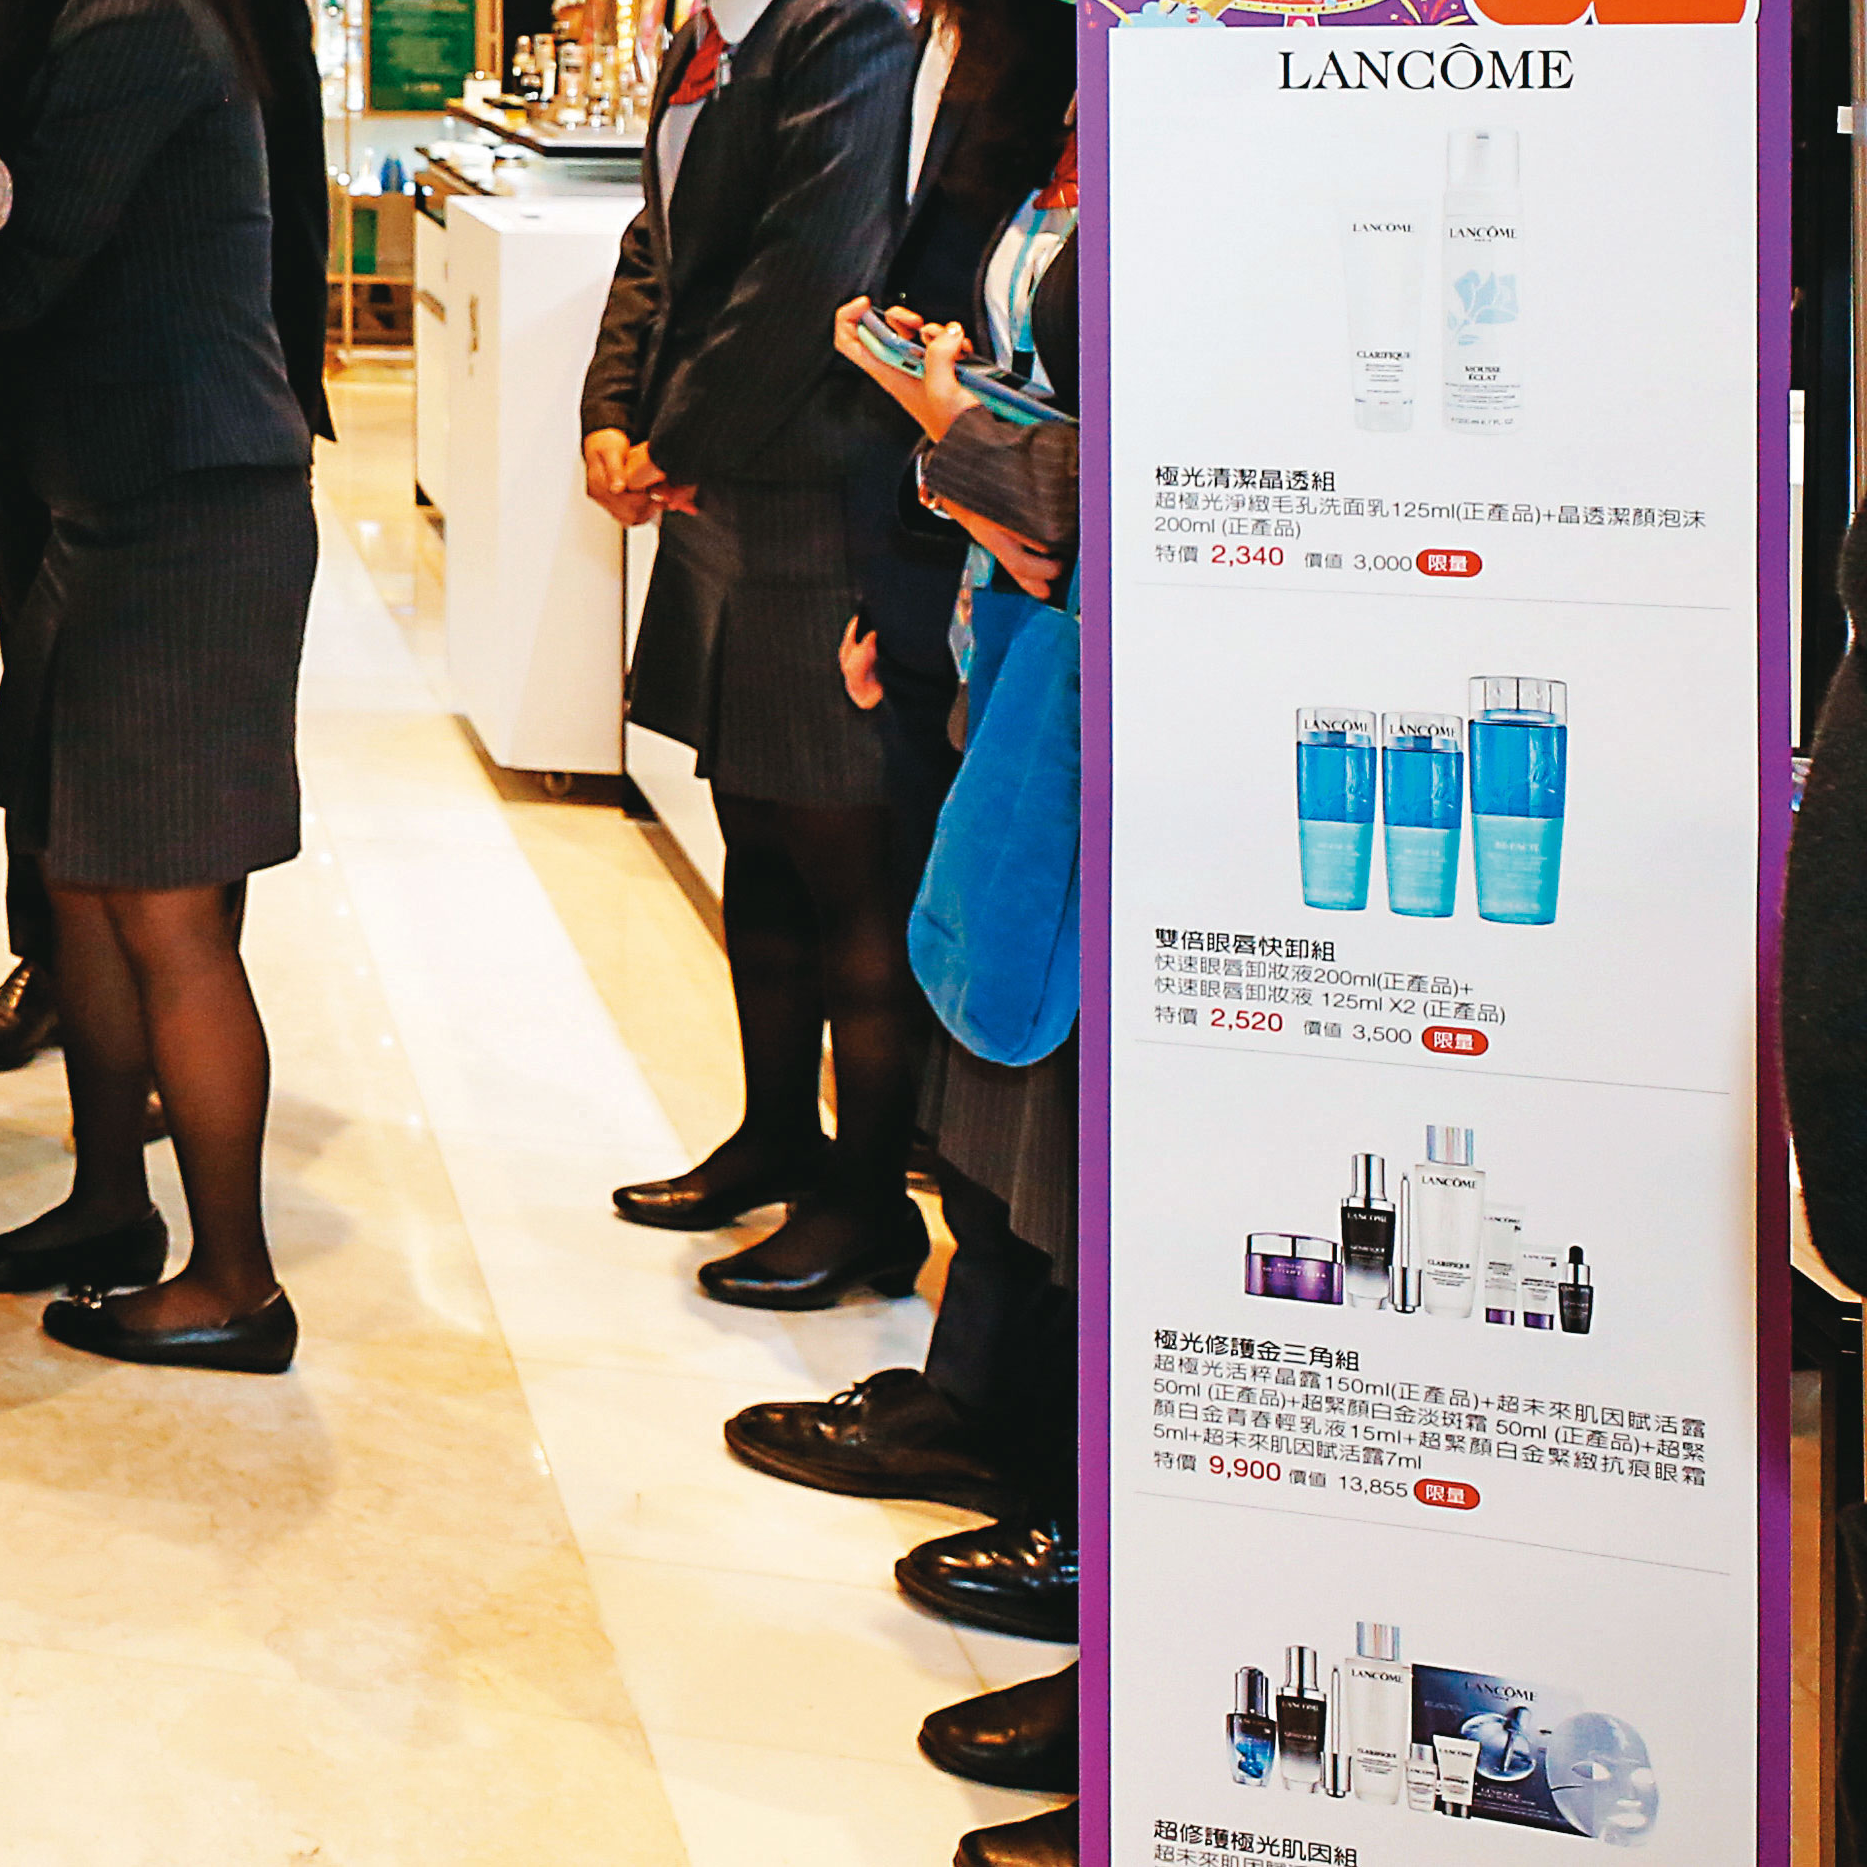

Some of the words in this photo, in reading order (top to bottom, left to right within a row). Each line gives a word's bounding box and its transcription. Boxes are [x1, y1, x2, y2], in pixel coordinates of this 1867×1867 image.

[1278, 41, 1574, 90] LANCÔME
[1155, 466, 1337, 492] 極光清潔晶透組
[1154, 516, 1215, 534] 200ml
[1222, 517, 1301, 540] (正產品)
[1155, 544, 1199, 564] 特價
[1211, 544, 1285, 568] 2,340
[1304, 553, 1343, 570] 價值
[1353, 555, 1413, 572] 3,000
[1427, 554, 1469, 573] 限量
[1155, 928, 1336, 963] 雙倍眼唇快卸組
[1155, 1006, 1198, 1027] 特價
[1210, 1007, 1284, 1033] 2,520
[1303, 1020, 1343, 1039] 價值
[1352, 1024, 1413, 1045] 3,500
[1433, 1031, 1475, 1051] 限量
[1321, 992, 1384, 1013] 125ml
[1390, 997, 1417, 1014] X2
[1423, 998, 1507, 1025] (正產品)
[1154, 1328, 1360, 1372] 極光修護金三角組
[1153, 1378, 1202, 1398] 50ml
[1496, 1419, 1547, 1441] 50ml
[1153, 1450, 1197, 1472] 特價
[1209, 1455, 1281, 1482] 9,900
[1288, 1468, 1327, 1488] 價值
[1338, 1475, 1409, 1498] 13,855
[1425, 1483, 1467, 1506] 限量
[1154, 1820, 1357, 1867] 超修護極光肌因組
